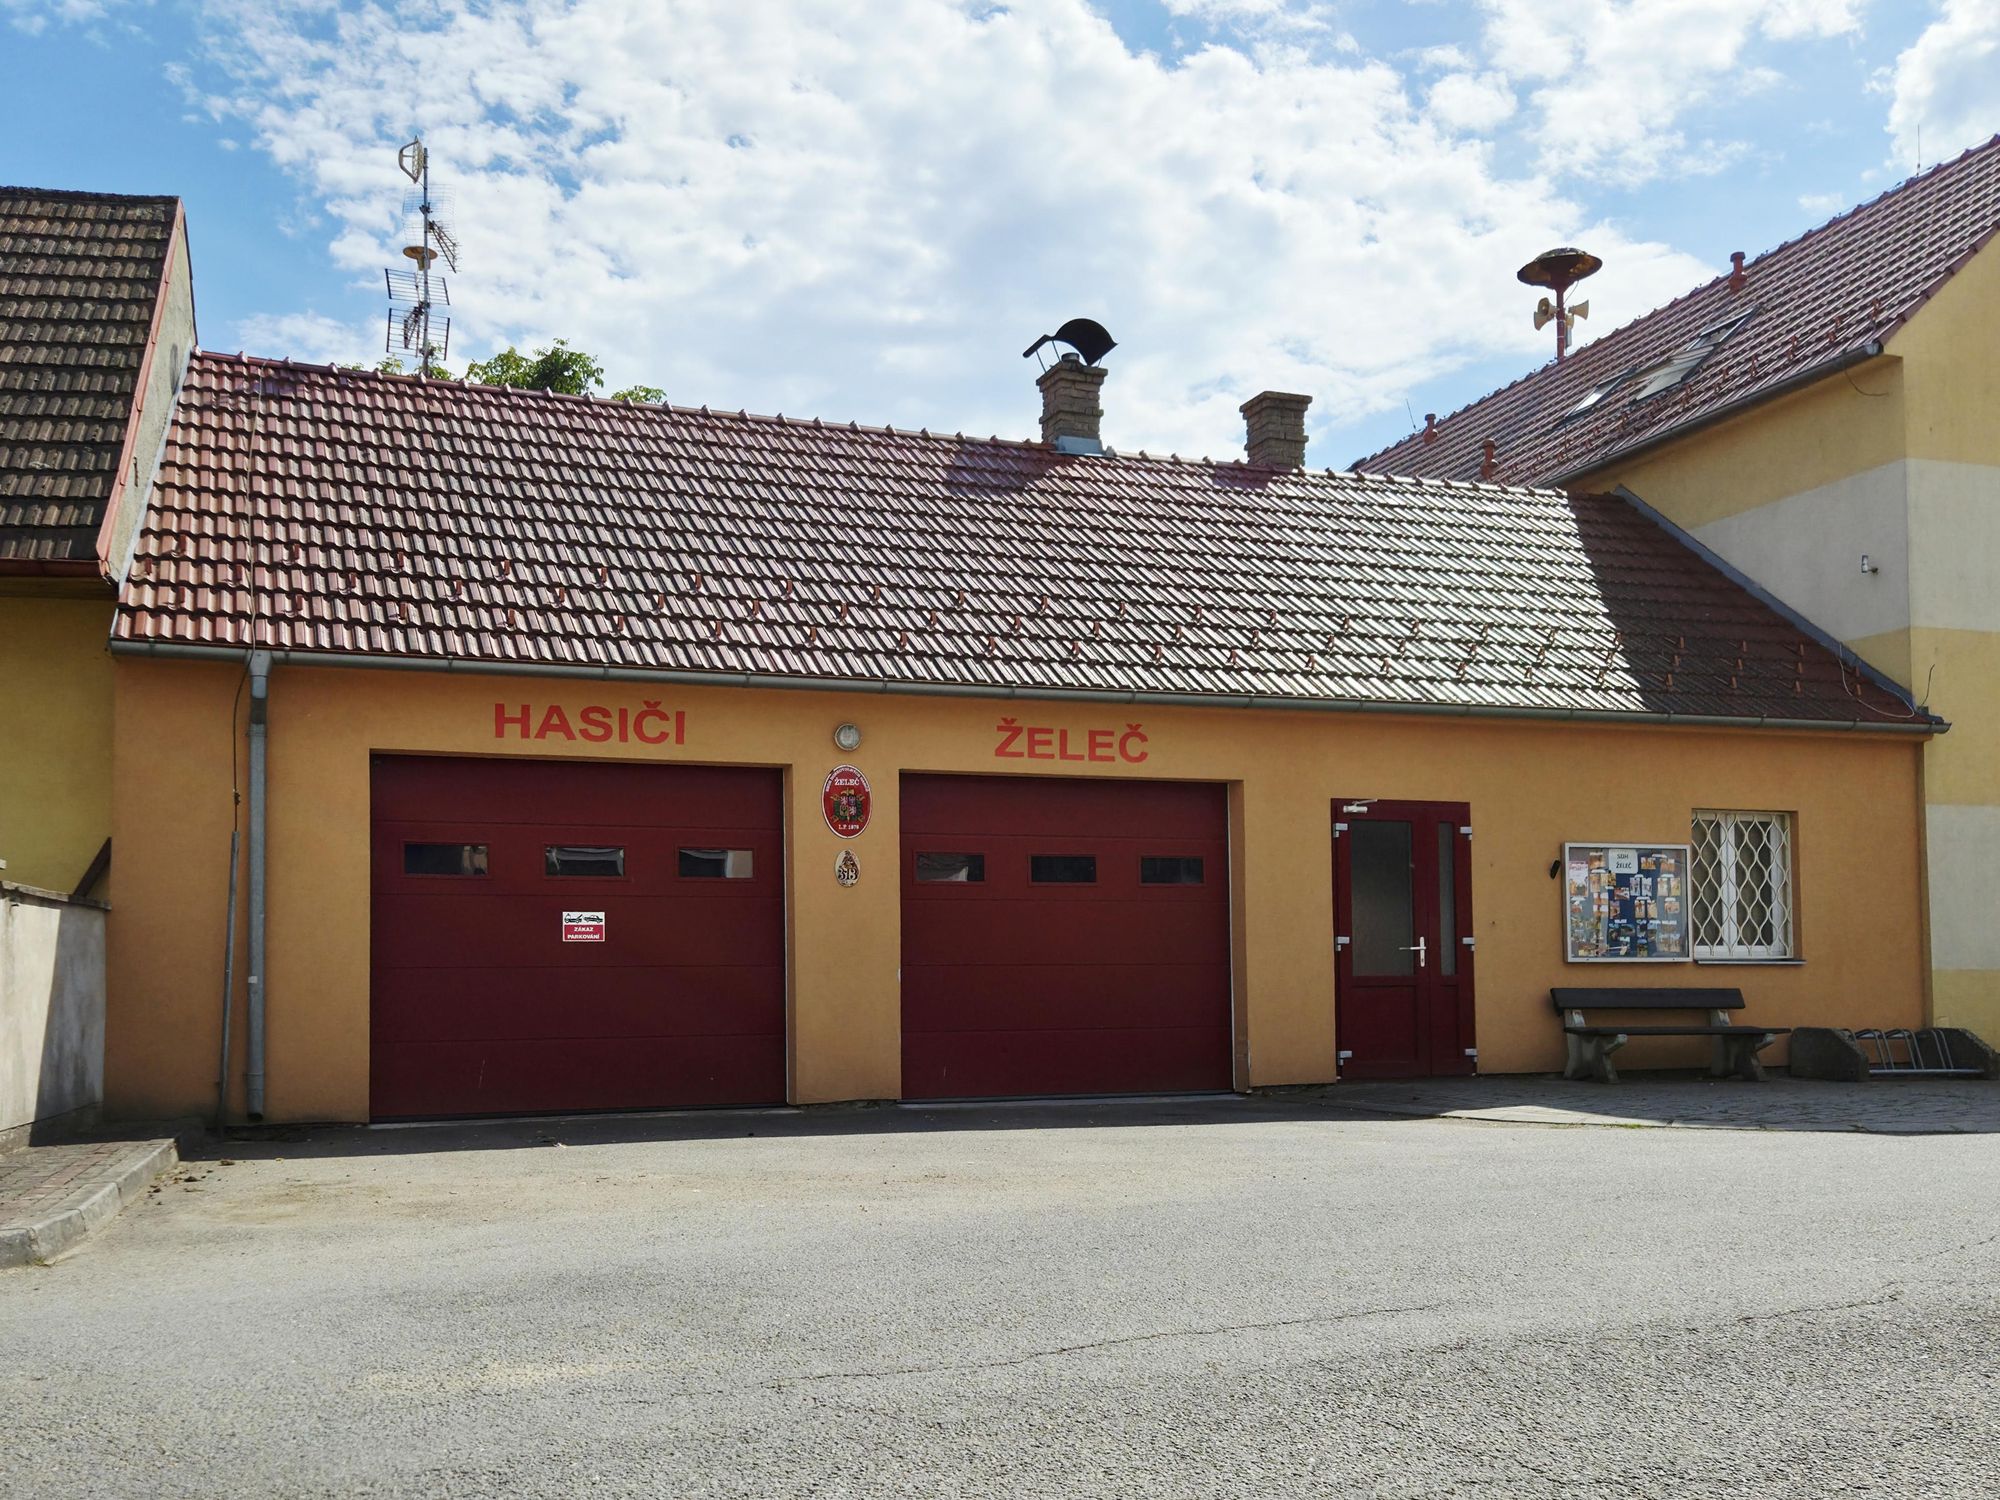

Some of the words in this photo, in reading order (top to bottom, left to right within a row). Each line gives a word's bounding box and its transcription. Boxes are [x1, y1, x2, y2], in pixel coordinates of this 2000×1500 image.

[495, 700, 686, 745] HASIČI
[994, 717, 1149, 763] ŽELEČ
[834, 777, 860, 786] ŽELEČ
[838, 865, 858, 880] 313
[1616, 861, 1632, 869] ŽELEČ
